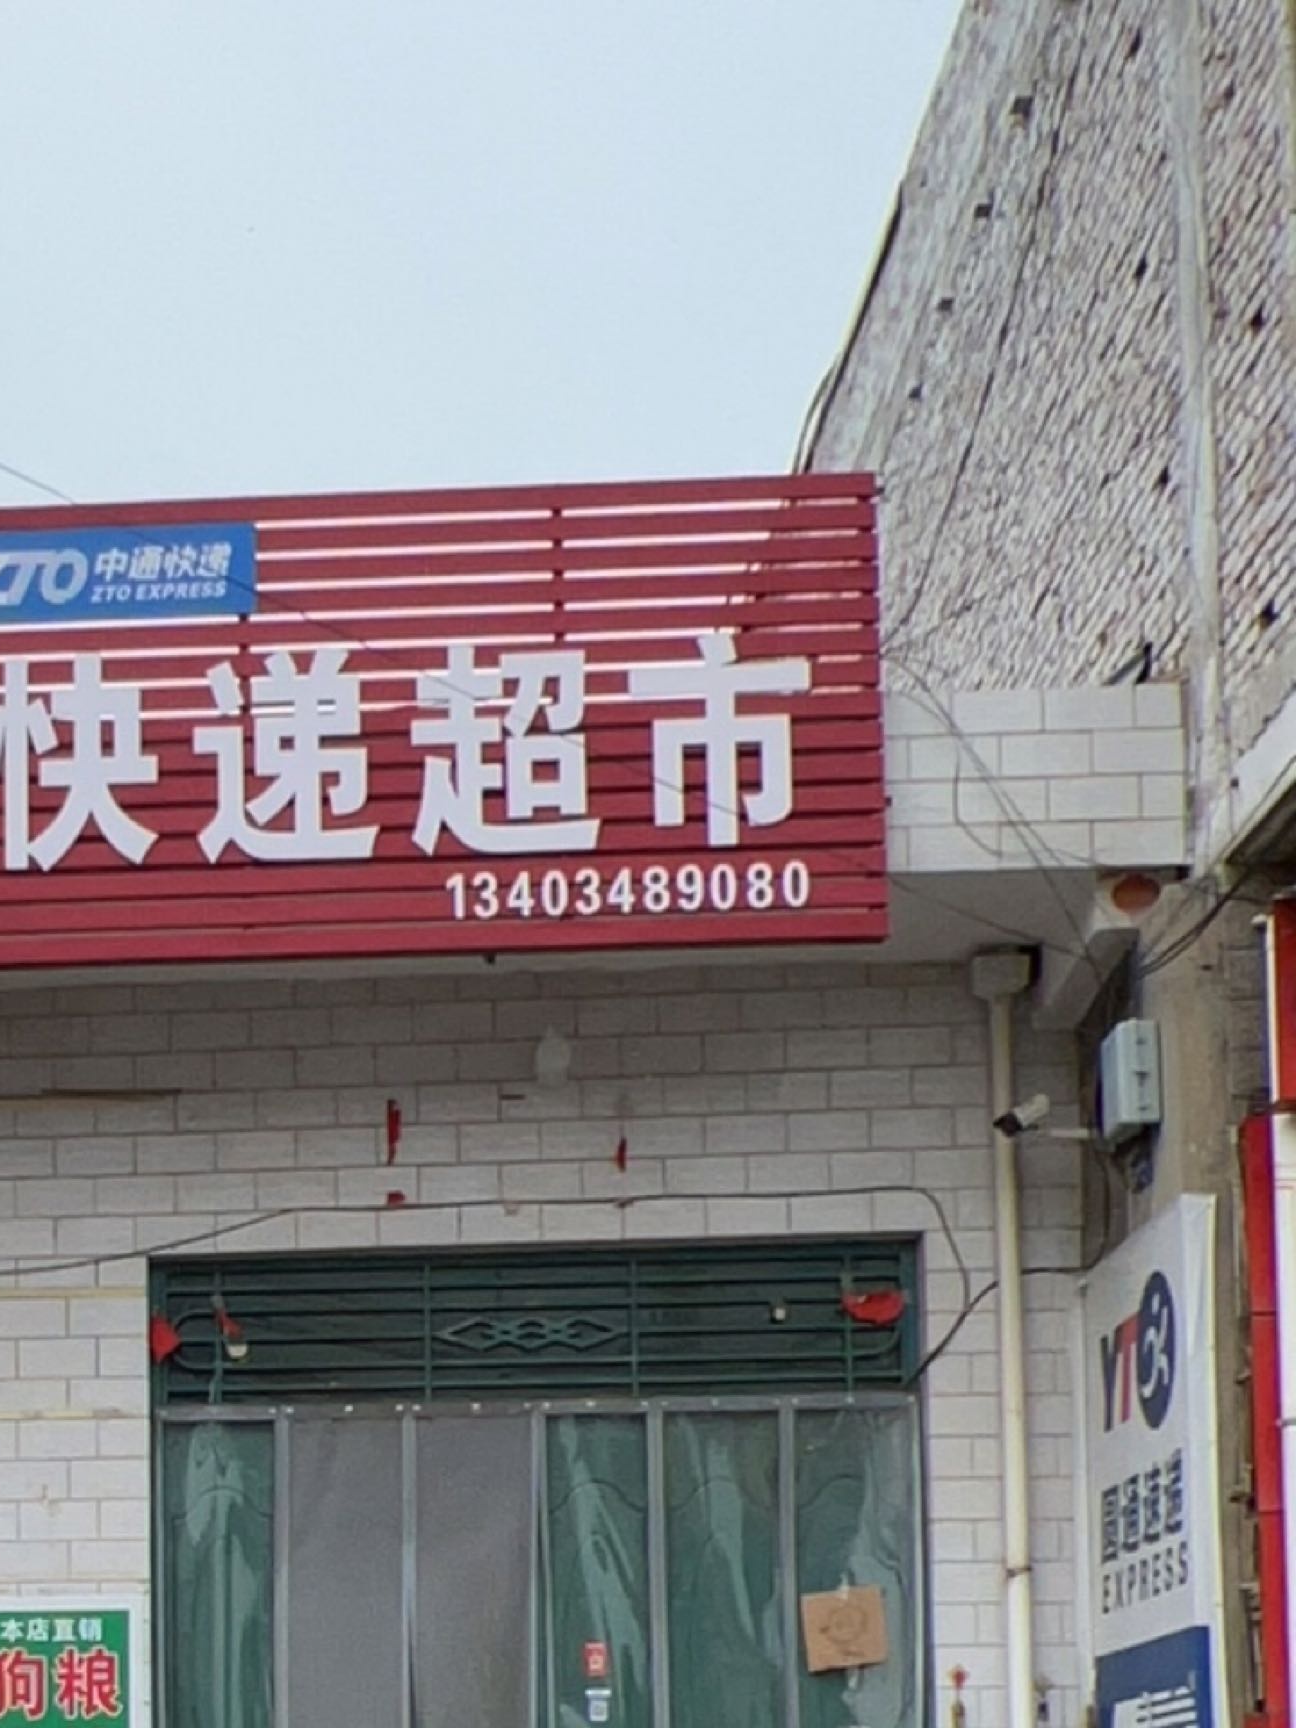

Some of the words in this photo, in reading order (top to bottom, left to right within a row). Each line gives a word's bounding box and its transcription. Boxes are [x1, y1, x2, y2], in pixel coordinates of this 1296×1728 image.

[95, 542, 232, 581] 中通快递
[91, 584, 130, 603] ZTO
[136, 580, 226, 601] EXPRESS
[445, 859, 810, 921] 13403489080
[1102, 1541, 1188, 1615] EXPRESS
